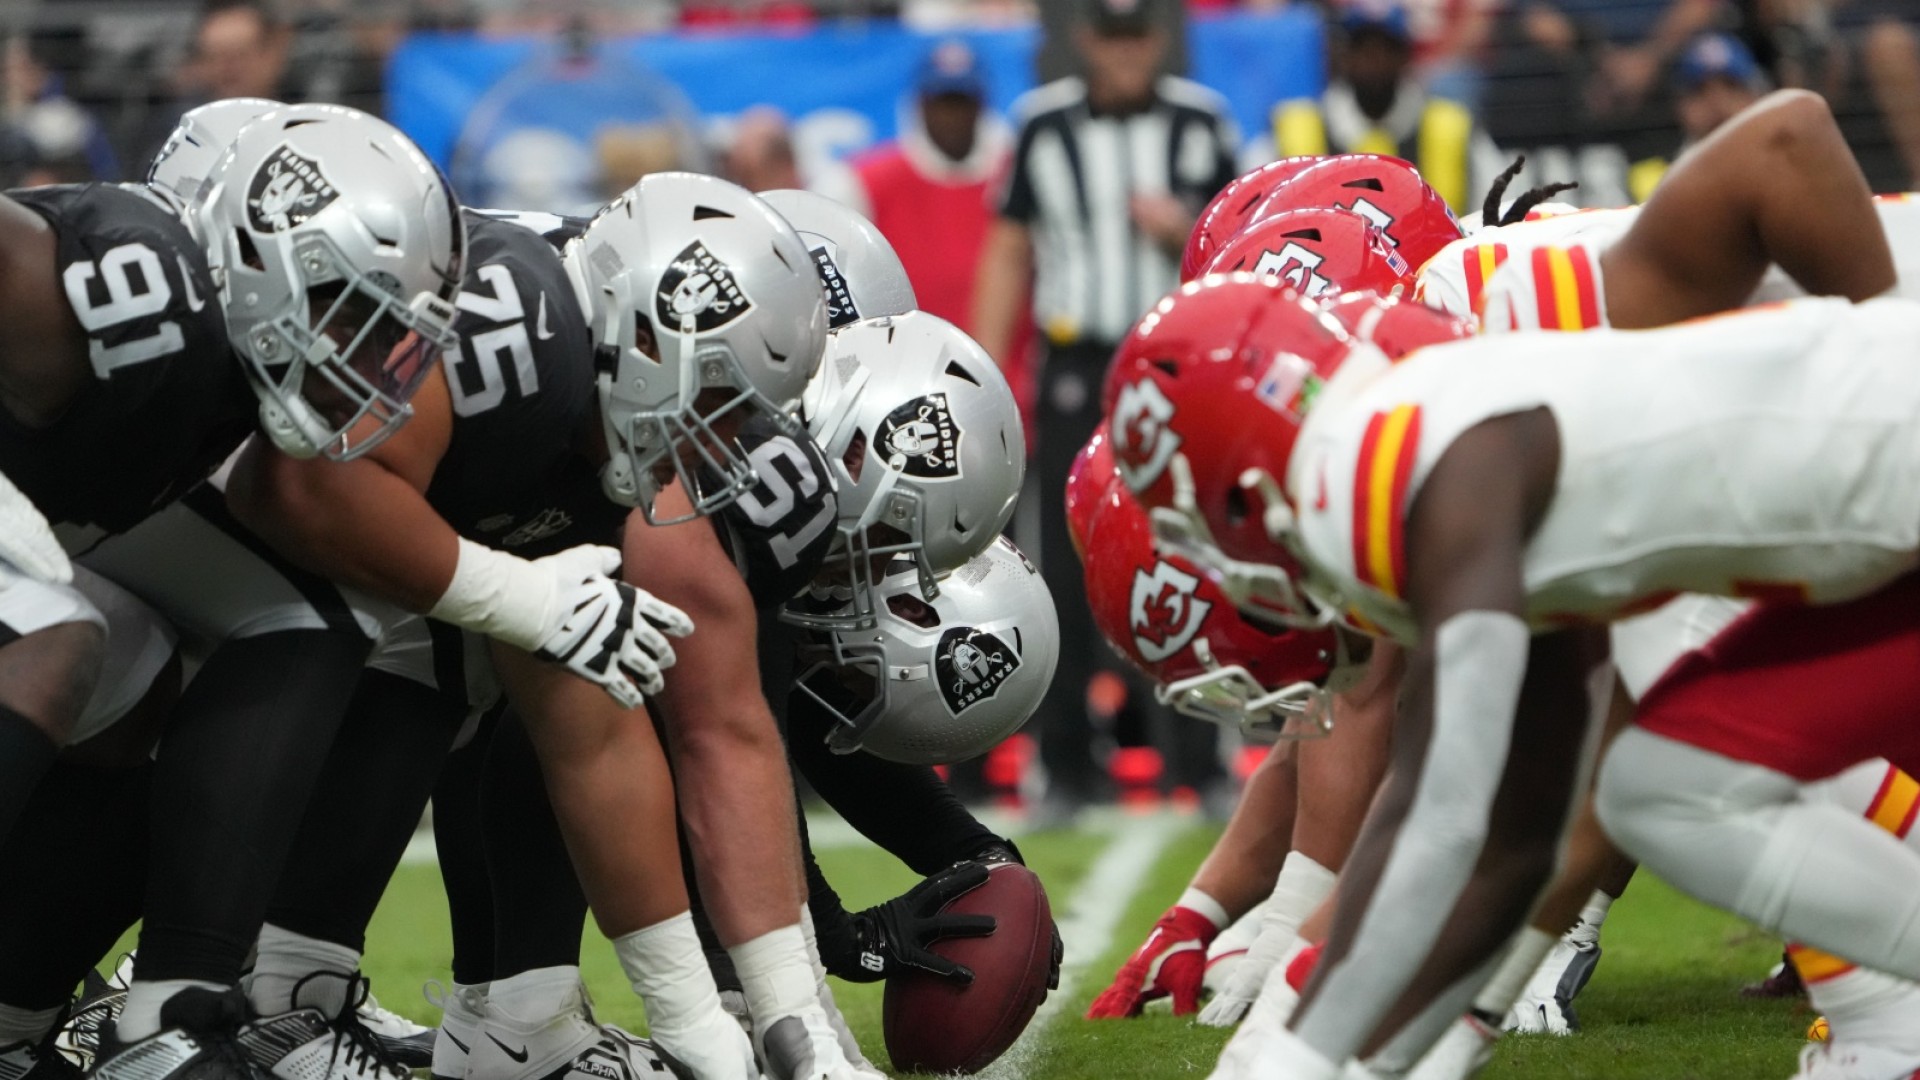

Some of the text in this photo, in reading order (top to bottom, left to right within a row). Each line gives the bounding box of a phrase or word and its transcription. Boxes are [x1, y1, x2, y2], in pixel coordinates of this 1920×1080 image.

[279, 148, 332, 197] RAIDERS
[694, 246, 744, 306] RAIDERS
[818, 254, 855, 315] RAIDERS
[62, 242, 185, 380] 91
[442, 264, 539, 418] 75
[936, 396, 956, 469] RAIDERS
[732, 436, 837, 570] 61
[957, 662, 1013, 708] RAIDERS
[576, 1060, 618, 1079] ALPHA
